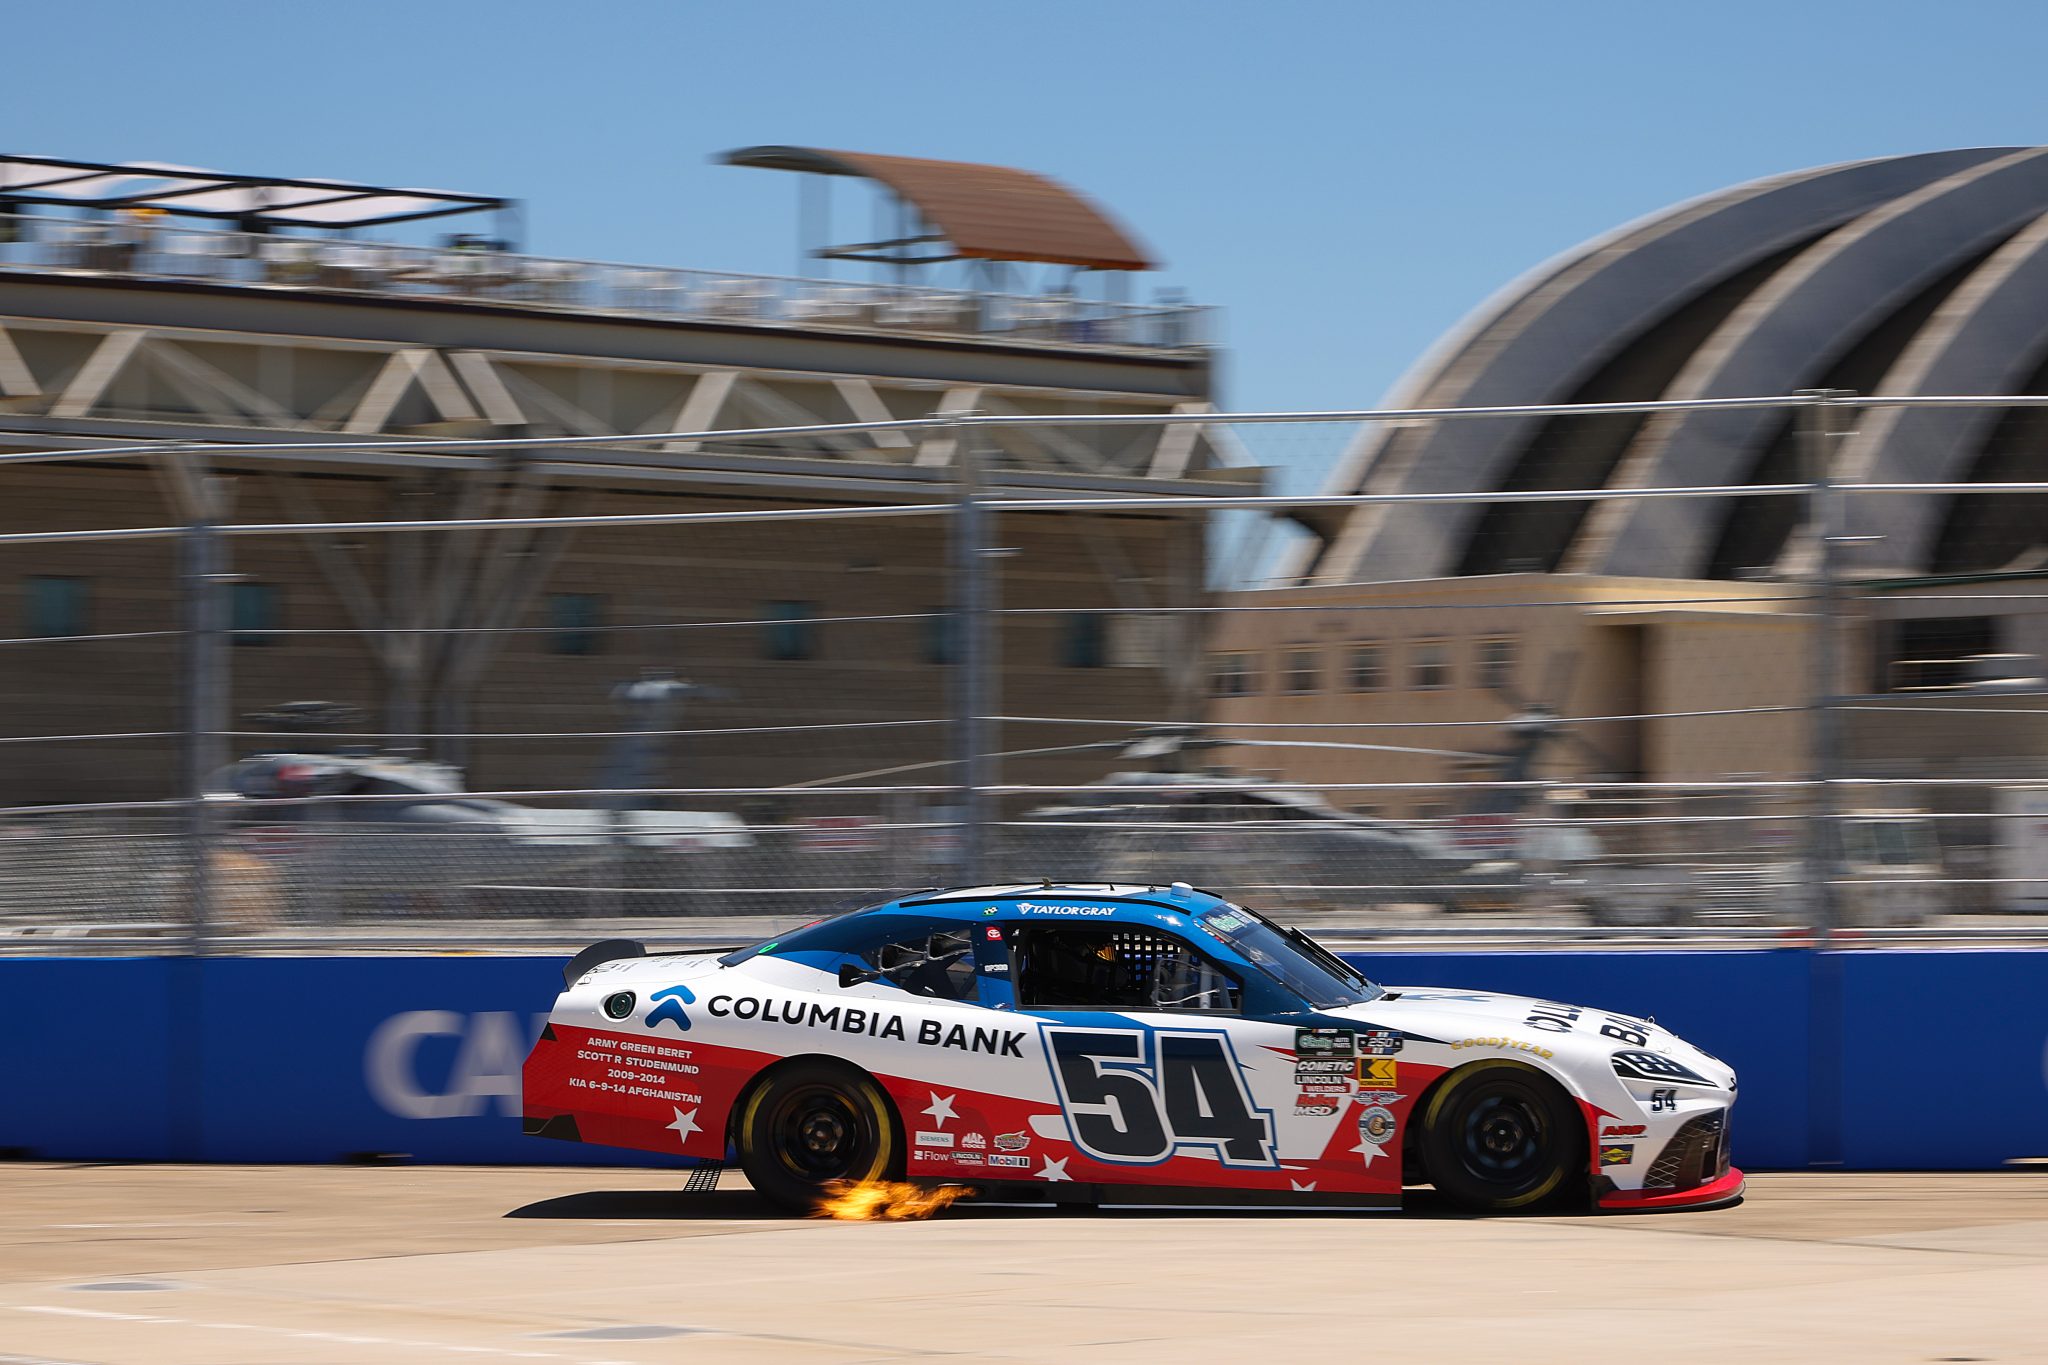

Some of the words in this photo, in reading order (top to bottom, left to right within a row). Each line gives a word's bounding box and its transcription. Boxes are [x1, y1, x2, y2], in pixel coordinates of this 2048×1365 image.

[707, 995, 906, 1041] COLUMBIA
[917, 1019, 1027, 1059] BANK
[587, 1037, 618, 1049] ARMY
[620, 1042, 656, 1054] GREEN
[657, 1046, 693, 1059] BERET
[1367, 1037, 1394, 1048] 250
[1451, 1037, 1554, 1060] GOODYEAR
[362, 1009, 552, 1119] CA
[577, 1050, 613, 1062] SCOTT
[614, 1055, 622, 1064] R
[625, 1057, 699, 1074] STUDENMUND
[1297, 1061, 1355, 1071] COMETIC
[607, 1069, 666, 1084] 2009-2014
[1296, 1075, 1342, 1084] LINCOLN
[569, 1077, 587, 1088] KIA
[589, 1082, 626, 1094] 6-9-14
[627, 1086, 702, 1104] AFGHANISTAN
[1041, 1025, 1276, 1168] 54
[1651, 1088, 1678, 1112] 54
[1294, 1106, 1333, 1116] MSD
[1602, 1125, 1647, 1136] ARP
[919, 1135, 950, 1143] SIEMENS
[924, 1151, 950, 1161] Flow
[989, 1155, 1018, 1166] Mobil
